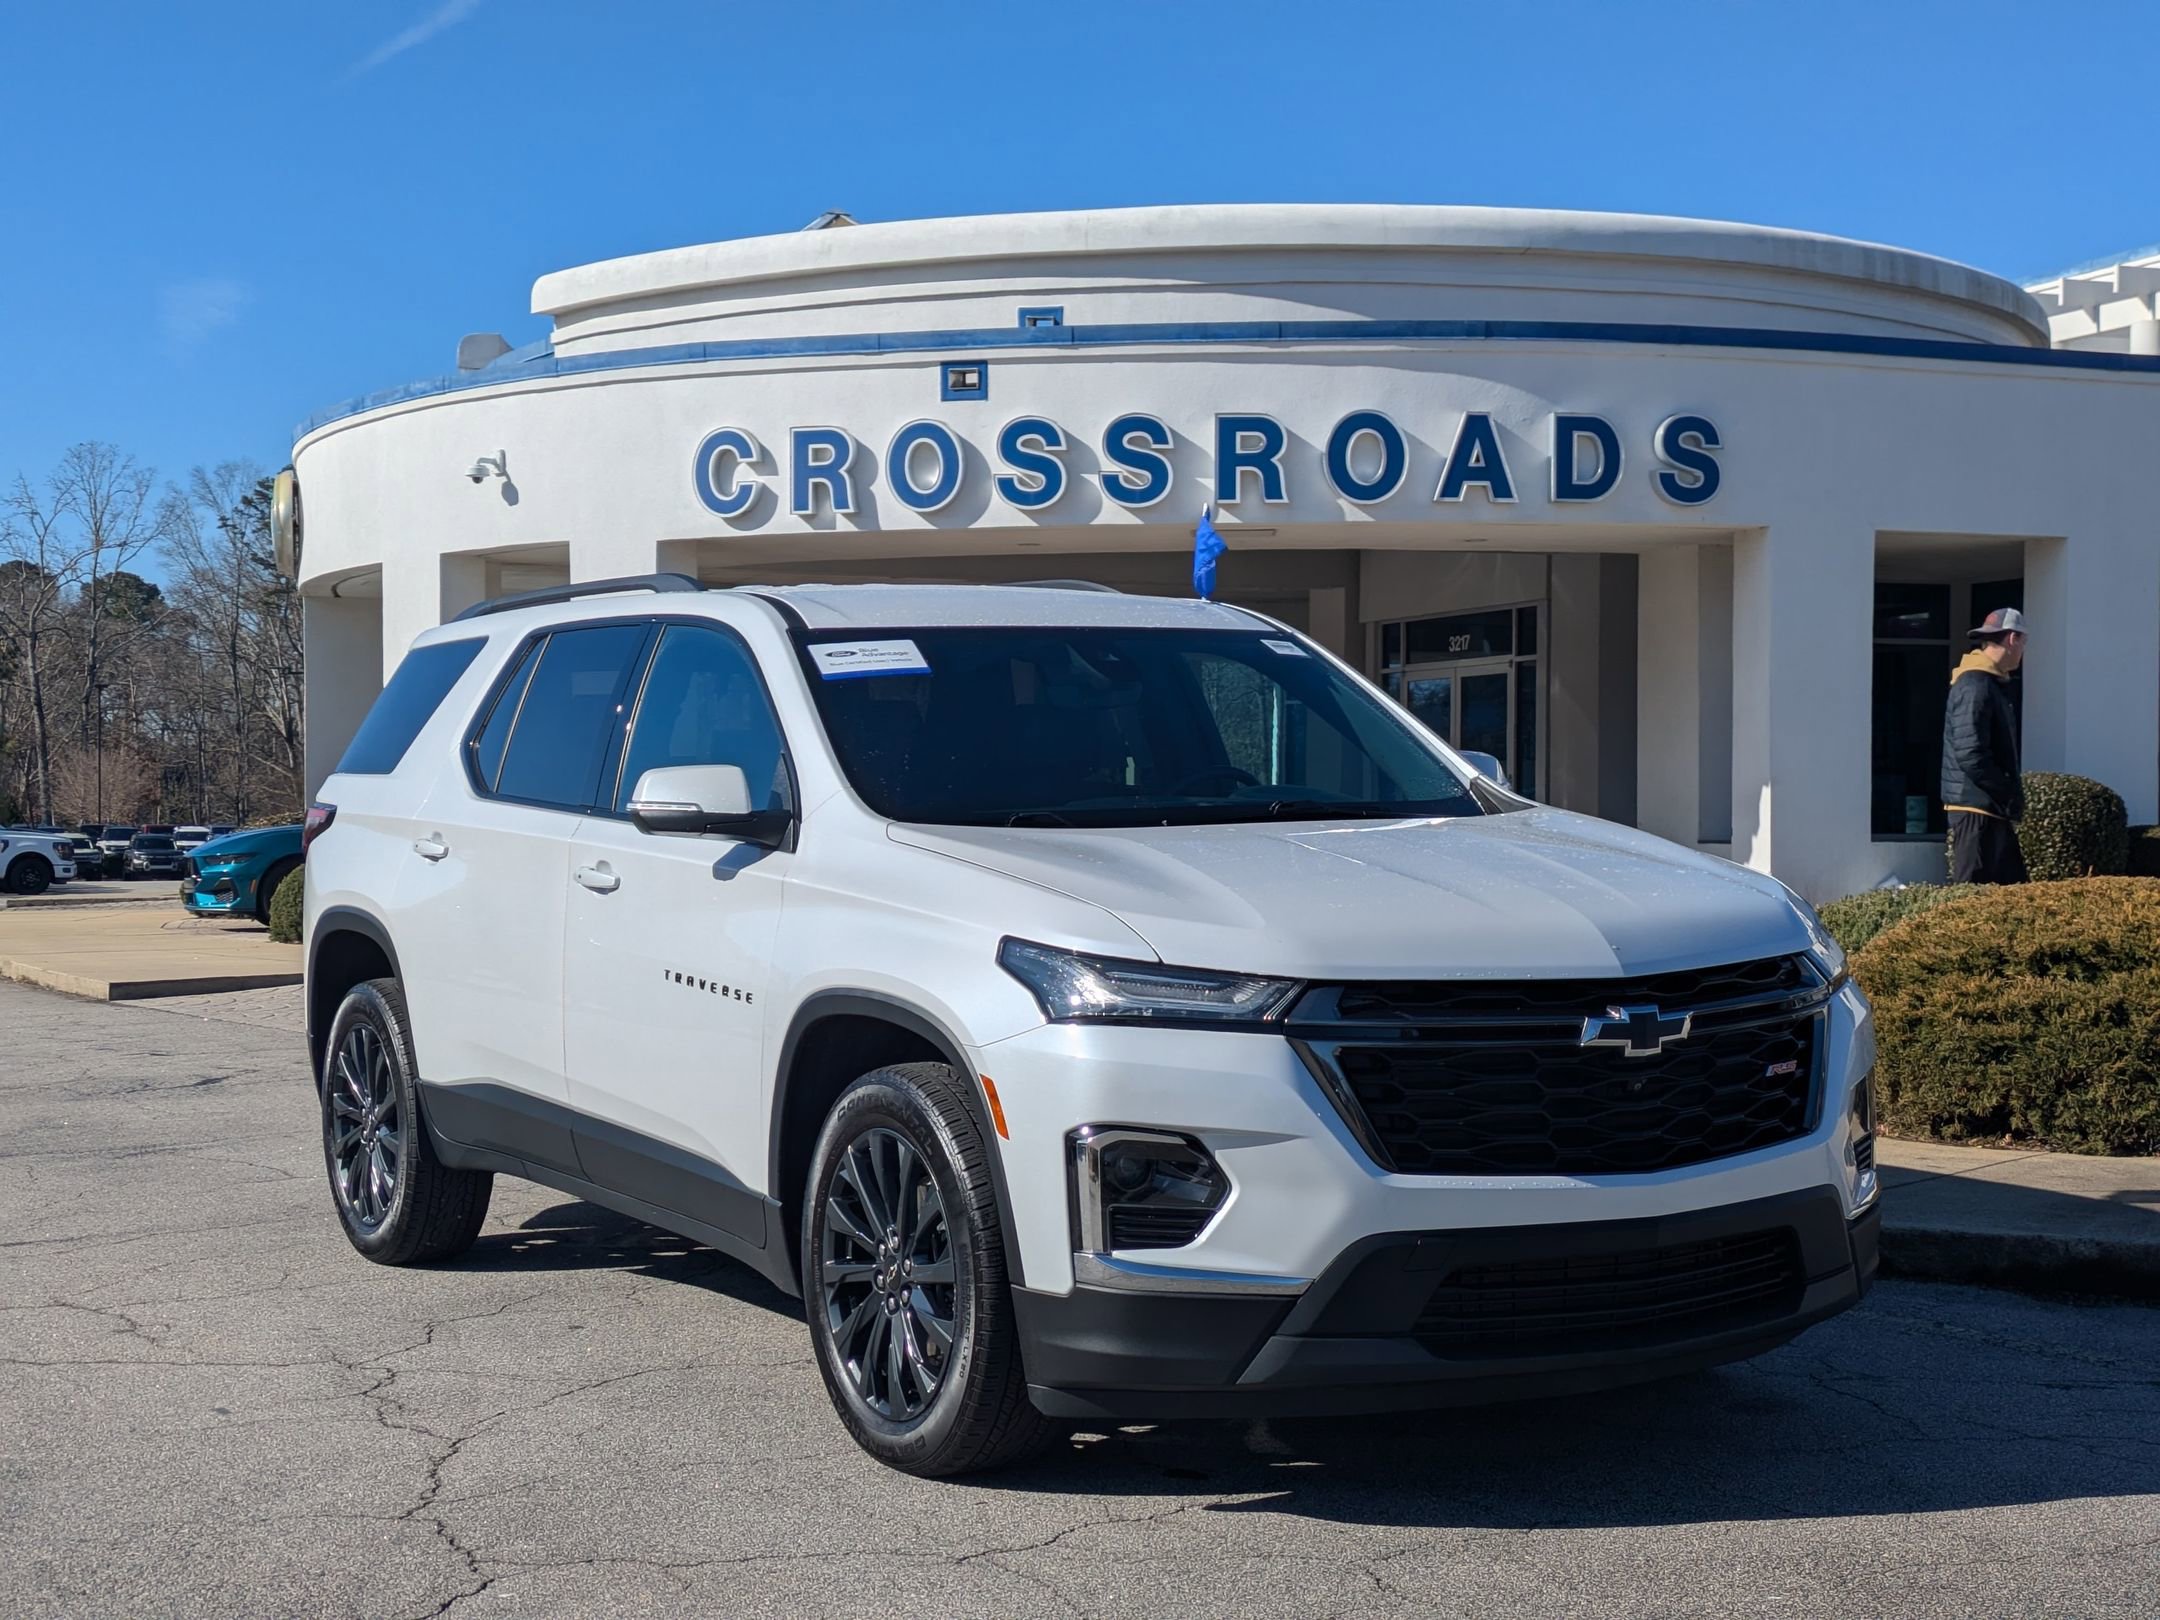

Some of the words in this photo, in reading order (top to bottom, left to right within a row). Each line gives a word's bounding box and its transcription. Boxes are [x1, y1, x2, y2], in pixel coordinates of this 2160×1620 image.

[692, 409, 1723, 519] CROSSROADS
[1449, 634, 1471, 652] 3217
[664, 969, 753, 1005] TRAVERSE
[1766, 1060, 1798, 1077] RS
